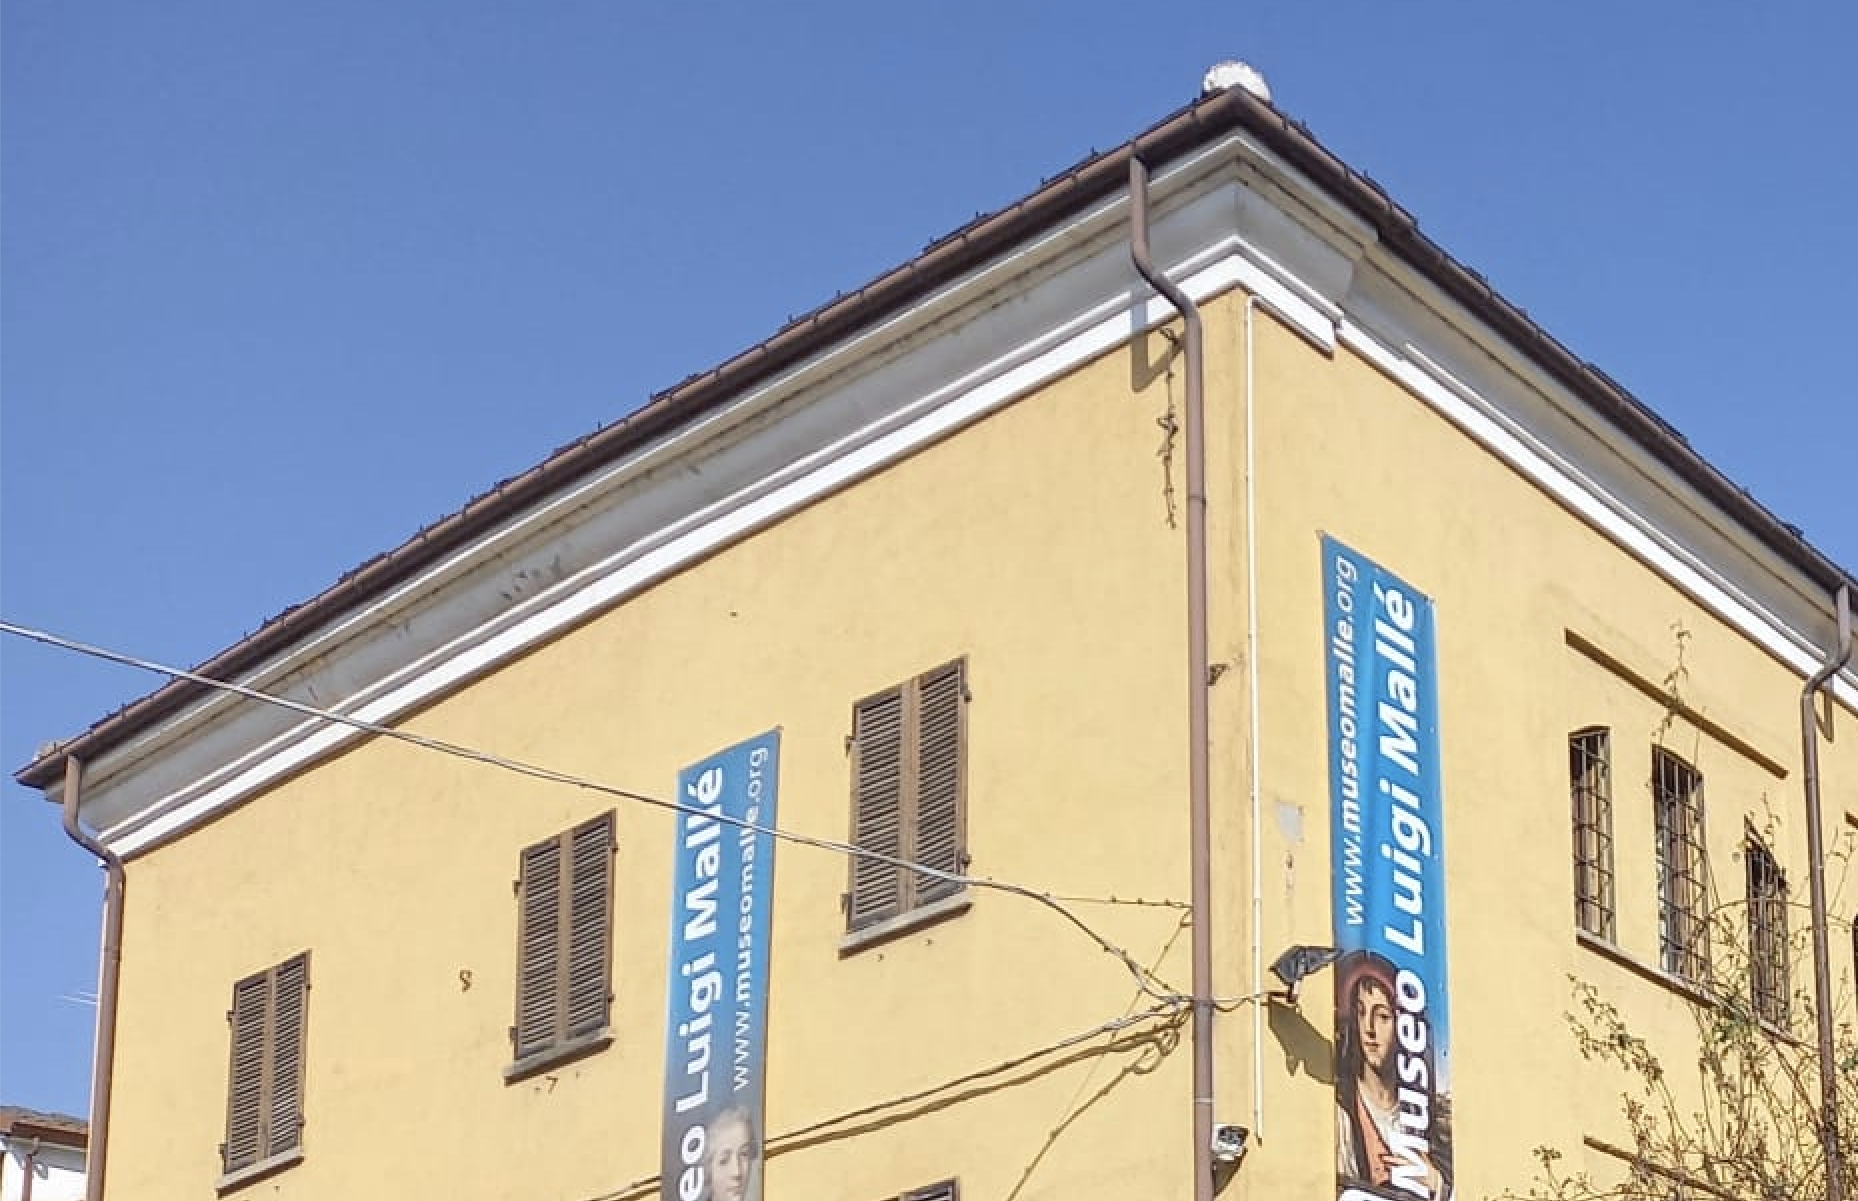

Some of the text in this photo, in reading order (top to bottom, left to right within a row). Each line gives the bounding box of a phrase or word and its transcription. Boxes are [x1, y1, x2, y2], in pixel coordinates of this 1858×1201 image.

[683, 767, 723, 940] Mallé
[1332, 556, 1364, 925] www.museomalle.org
[1373, 582, 1432, 1199] Museo Luigi Mallé
[676, 952, 723, 1112] Luigi
[733, 748, 768, 1091] www.museomalle.org
